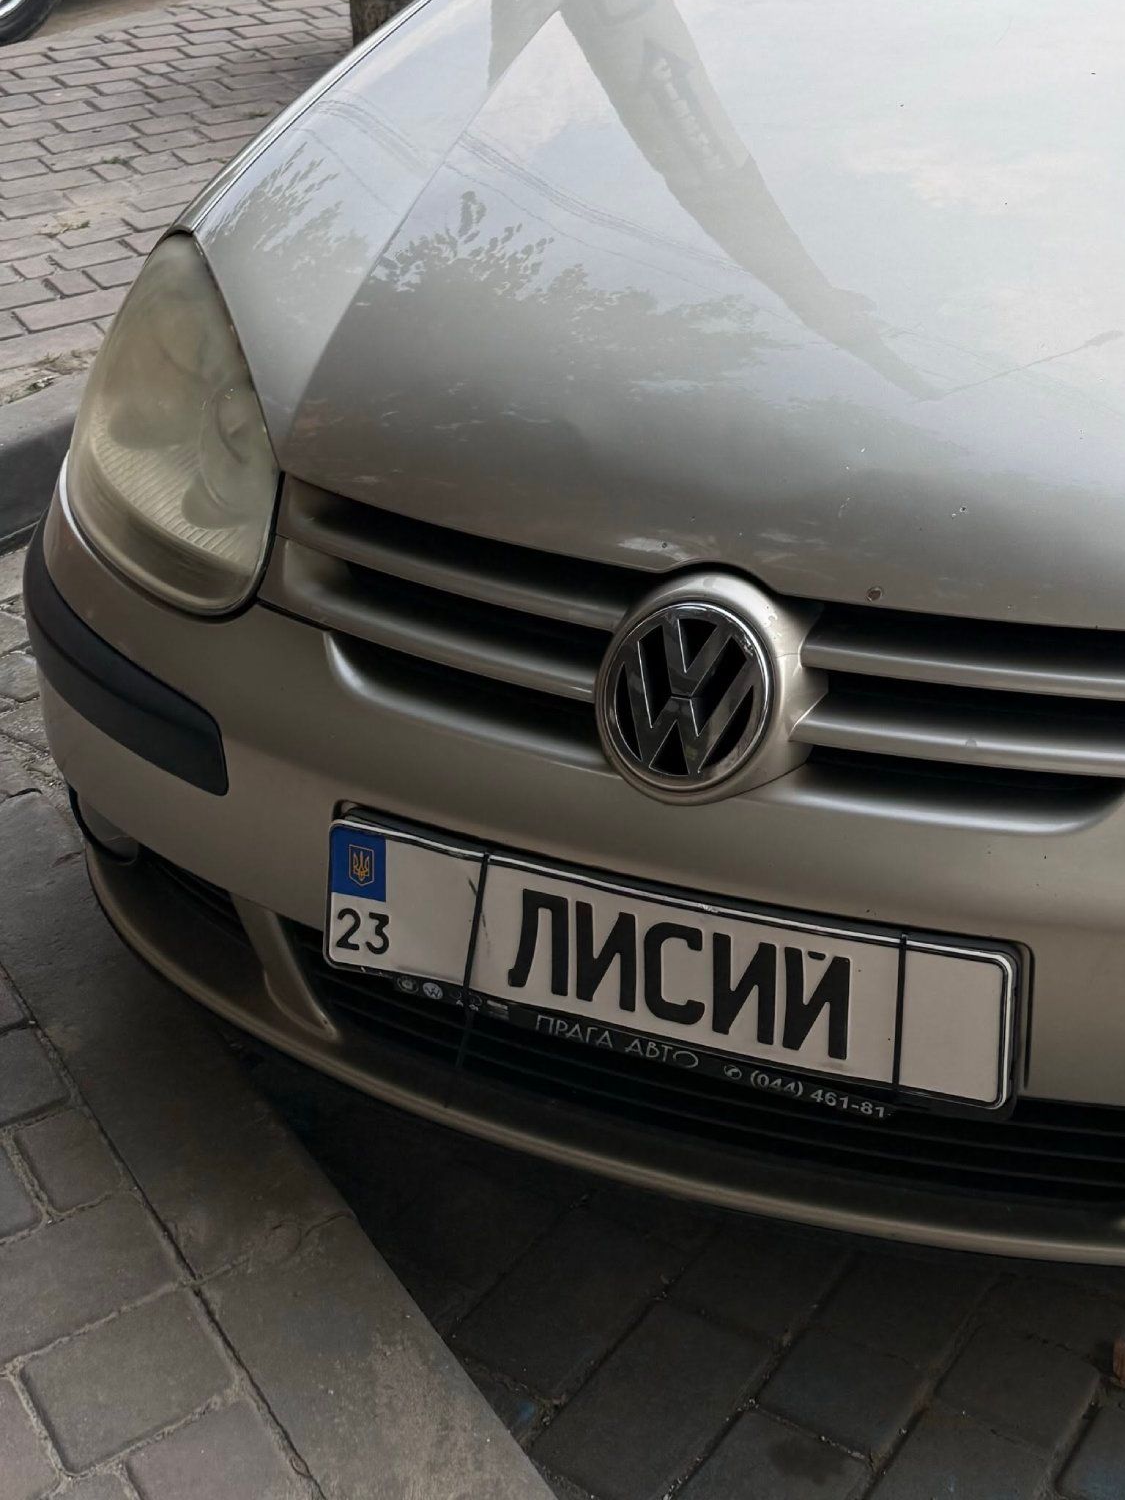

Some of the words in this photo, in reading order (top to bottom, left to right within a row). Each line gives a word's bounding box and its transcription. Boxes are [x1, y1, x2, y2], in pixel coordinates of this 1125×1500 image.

[336, 908, 390, 955] 23
[508, 888, 850, 1060] ЛИСИЙ
[534, 1014, 613, 1049] ПРАГА
[624, 1038, 699, 1069] АВТО
[749, 1069, 804, 1097] (044)
